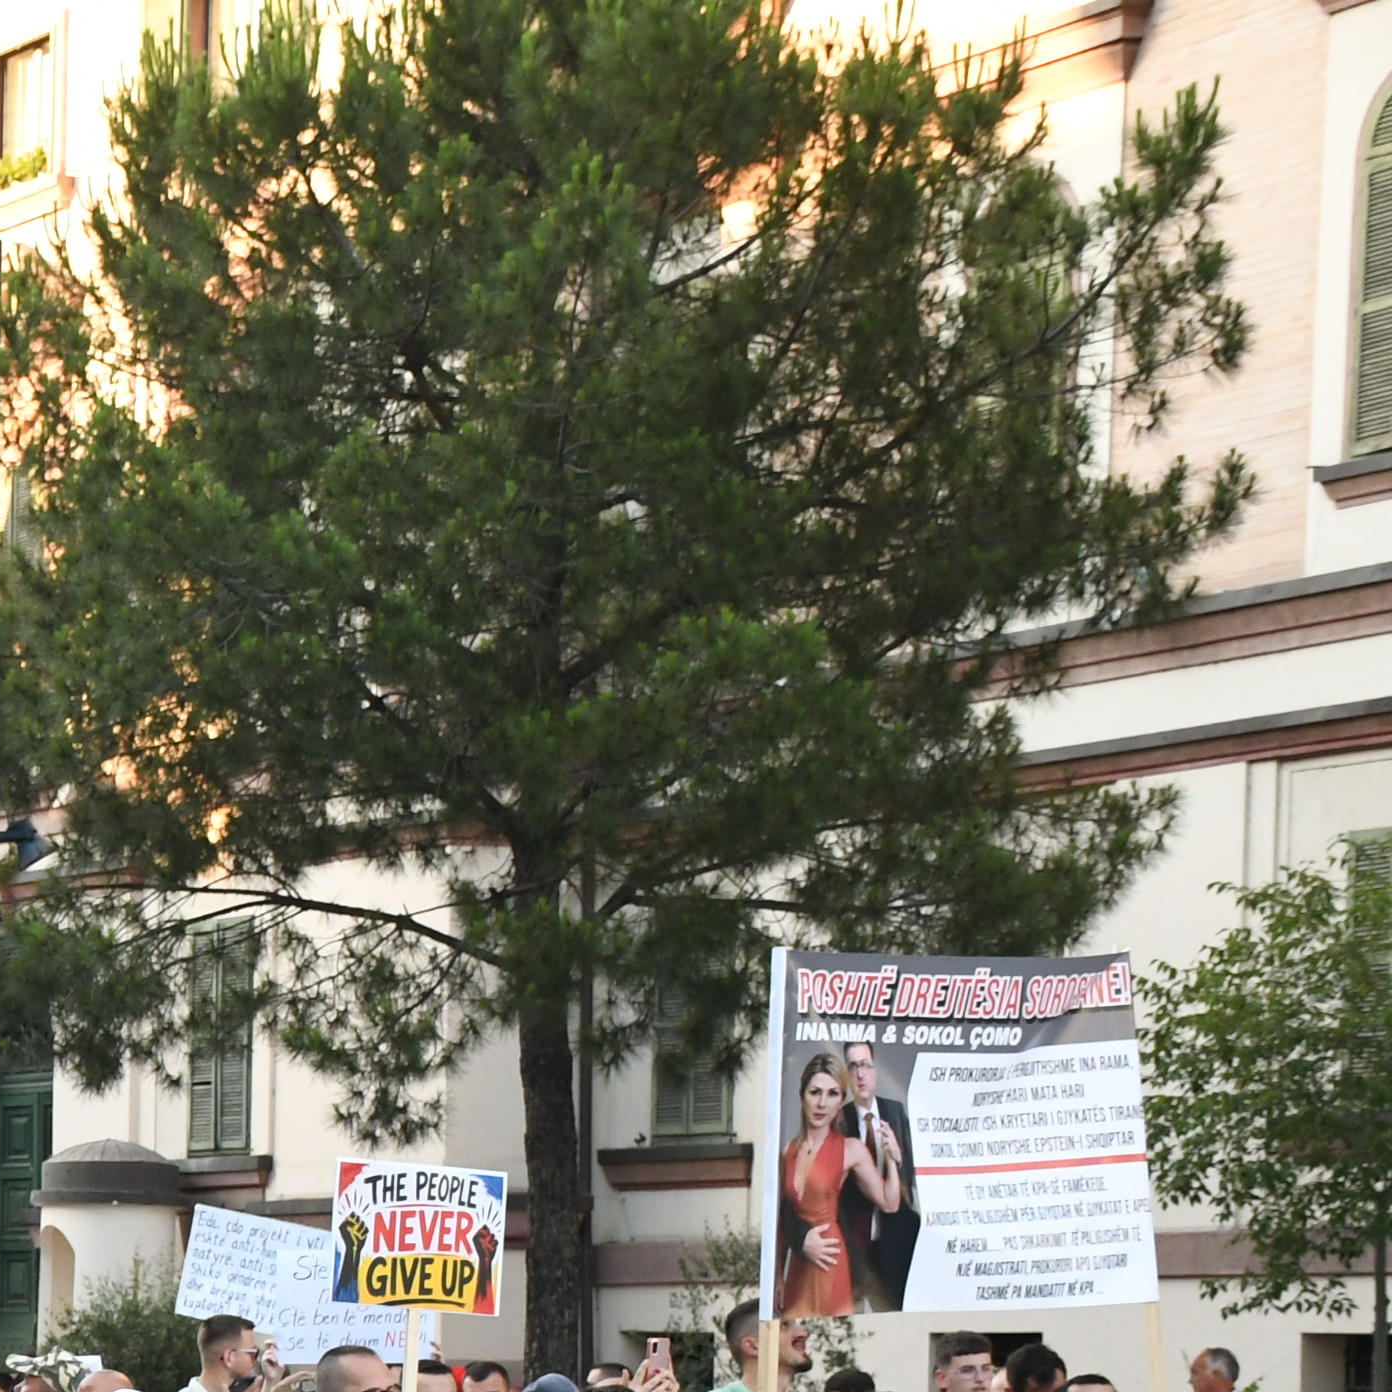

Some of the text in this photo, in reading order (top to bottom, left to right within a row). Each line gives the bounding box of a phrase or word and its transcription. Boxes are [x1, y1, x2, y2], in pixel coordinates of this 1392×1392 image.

[796, 964, 1022, 1019] POSHTË DREJTËSIA
[796, 1022, 827, 1041] INA
[831, 1022, 876, 1043] RAMA
[902, 1026, 965, 1045] SOKOL
[969, 1026, 1022, 1050] ÇOMO
[1079, 1056, 1096, 1072] INA
[1031, 1084, 1058, 1101] MATA
[1061, 1083, 1085, 1099] HARI
[1000, 1111, 1048, 1129] KRYETARI
[986, 1138, 1032, 1157] NDRYSHE
[364, 1171, 479, 1209] THE PEOPLE
[373, 1210, 474, 1255] NEVER
[366, 1256, 475, 1299] GIVE UP
